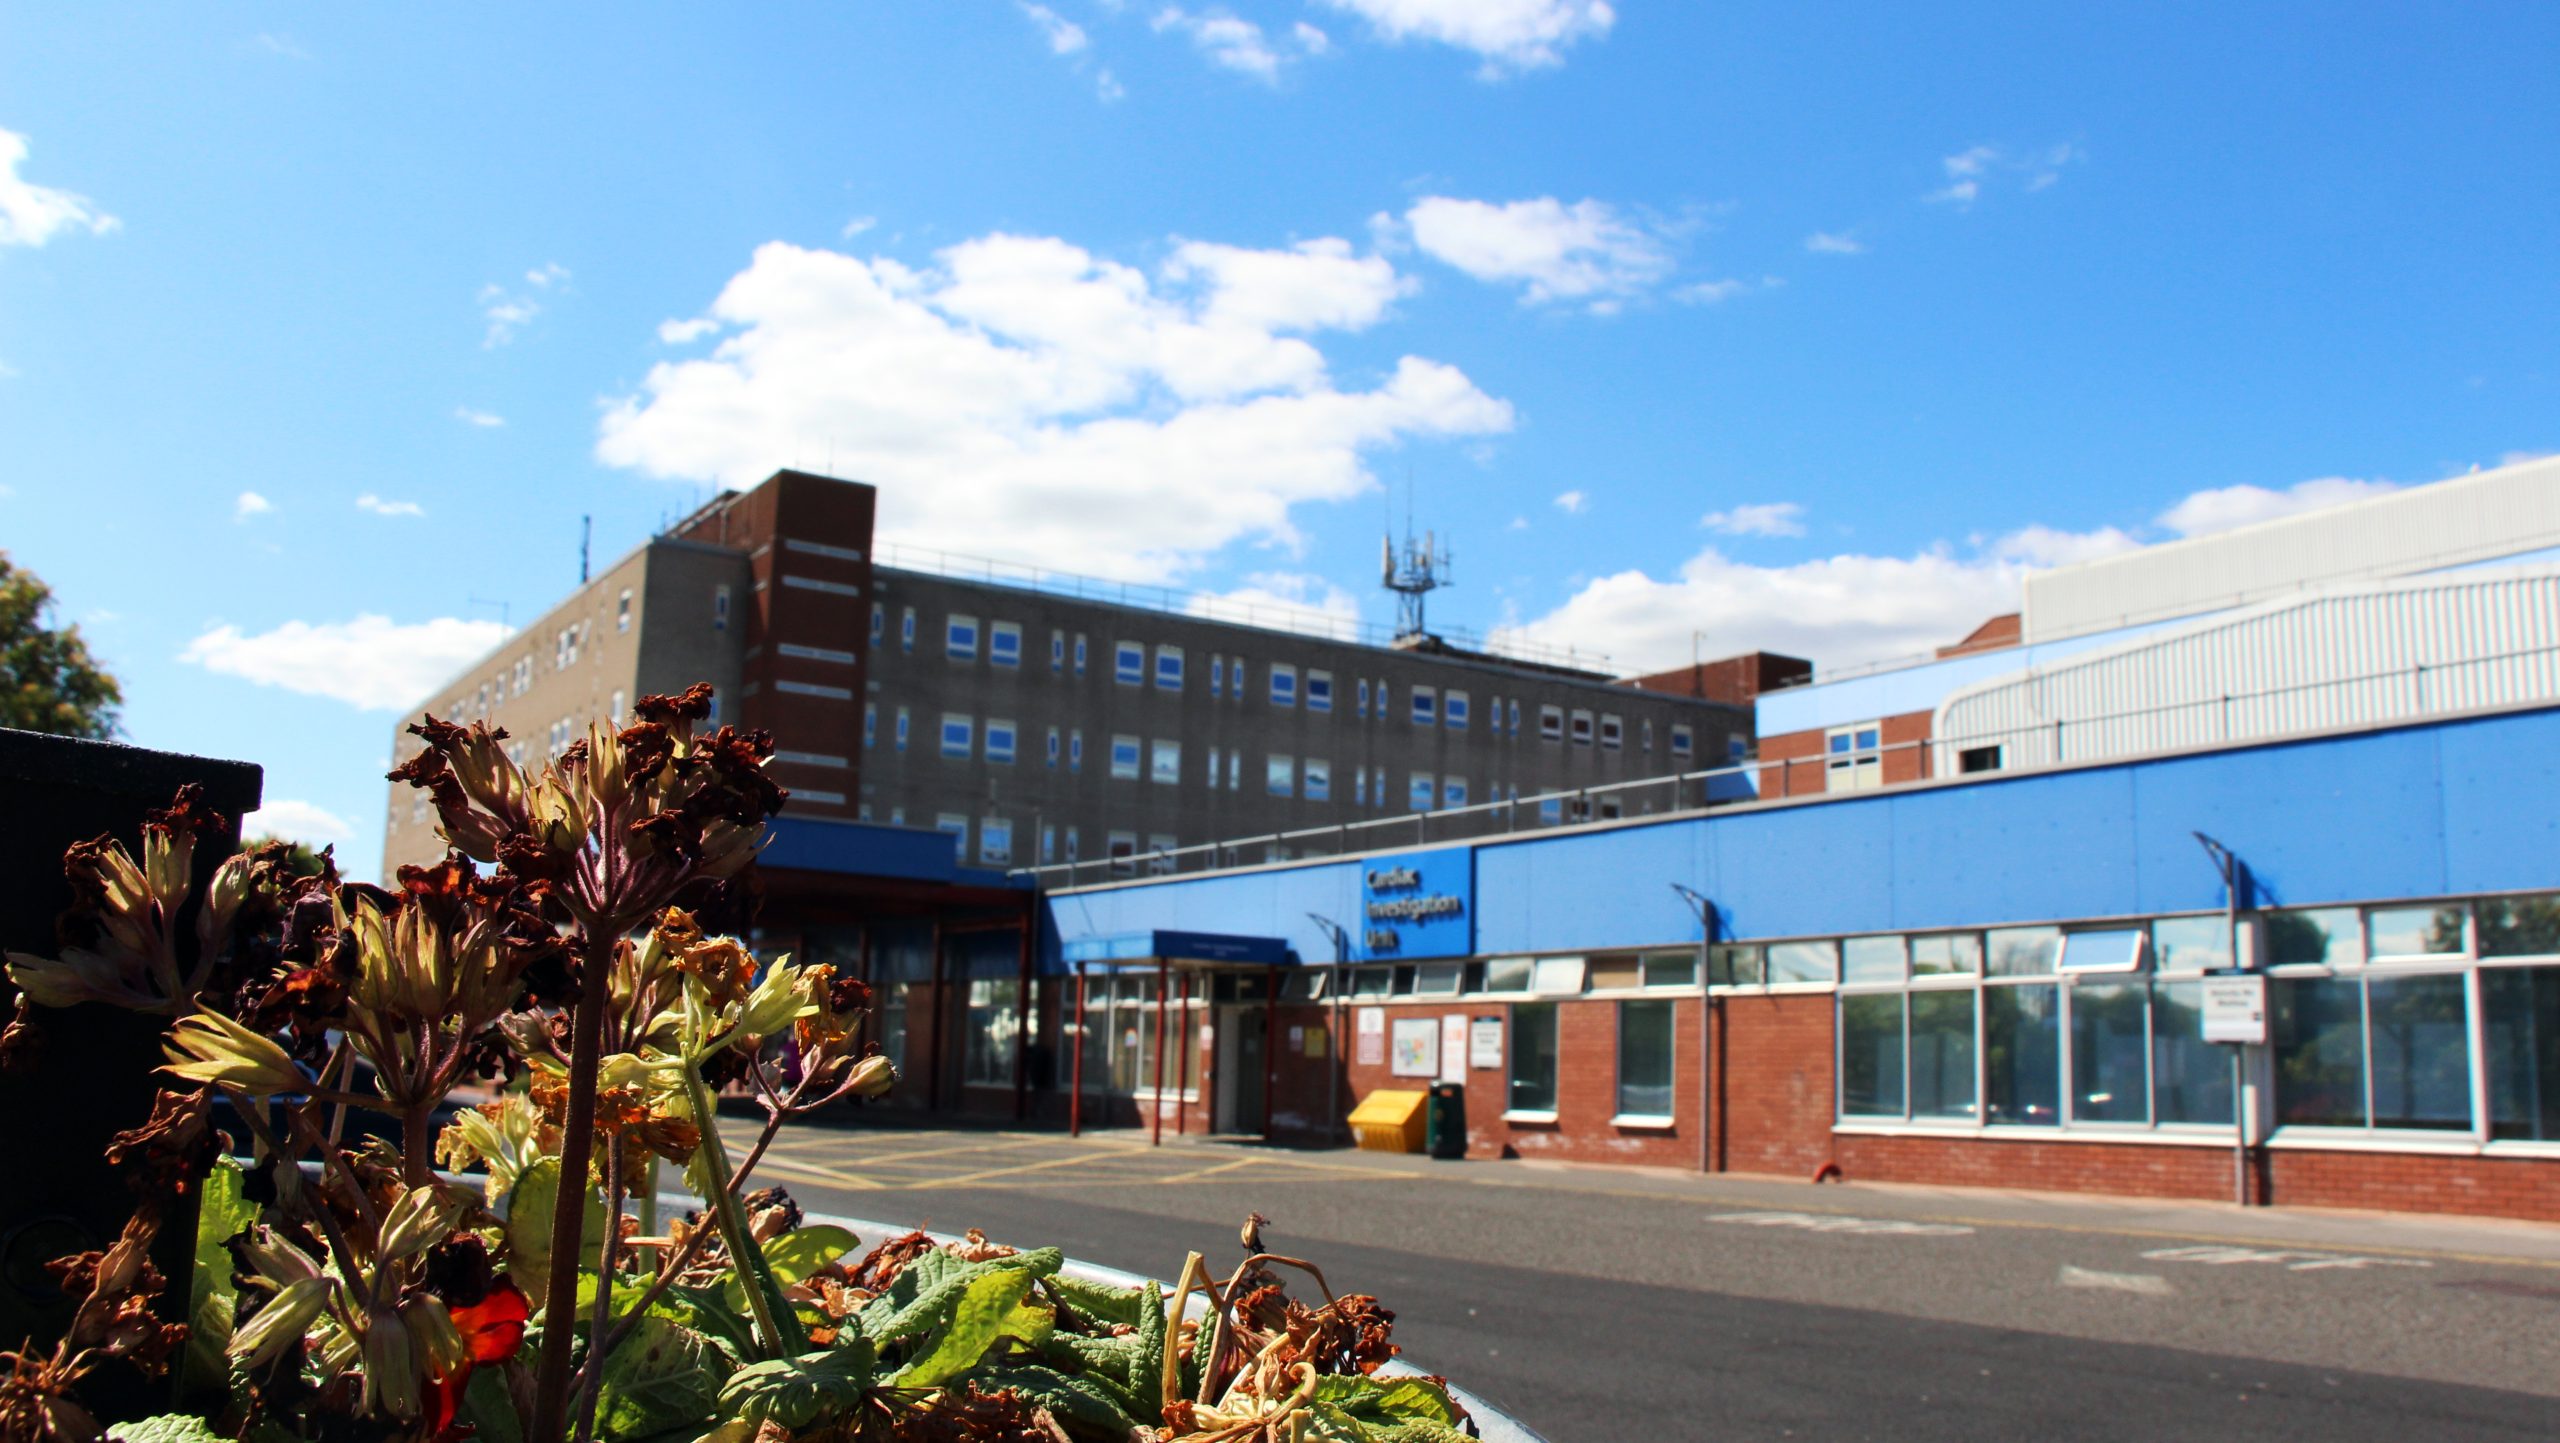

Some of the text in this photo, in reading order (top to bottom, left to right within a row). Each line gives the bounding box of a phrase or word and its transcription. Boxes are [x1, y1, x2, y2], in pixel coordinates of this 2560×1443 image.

[1367, 867, 1418, 888] Cardiac
[1366, 895, 1459, 920] Investigation
[1366, 929, 1396, 948] Unit
